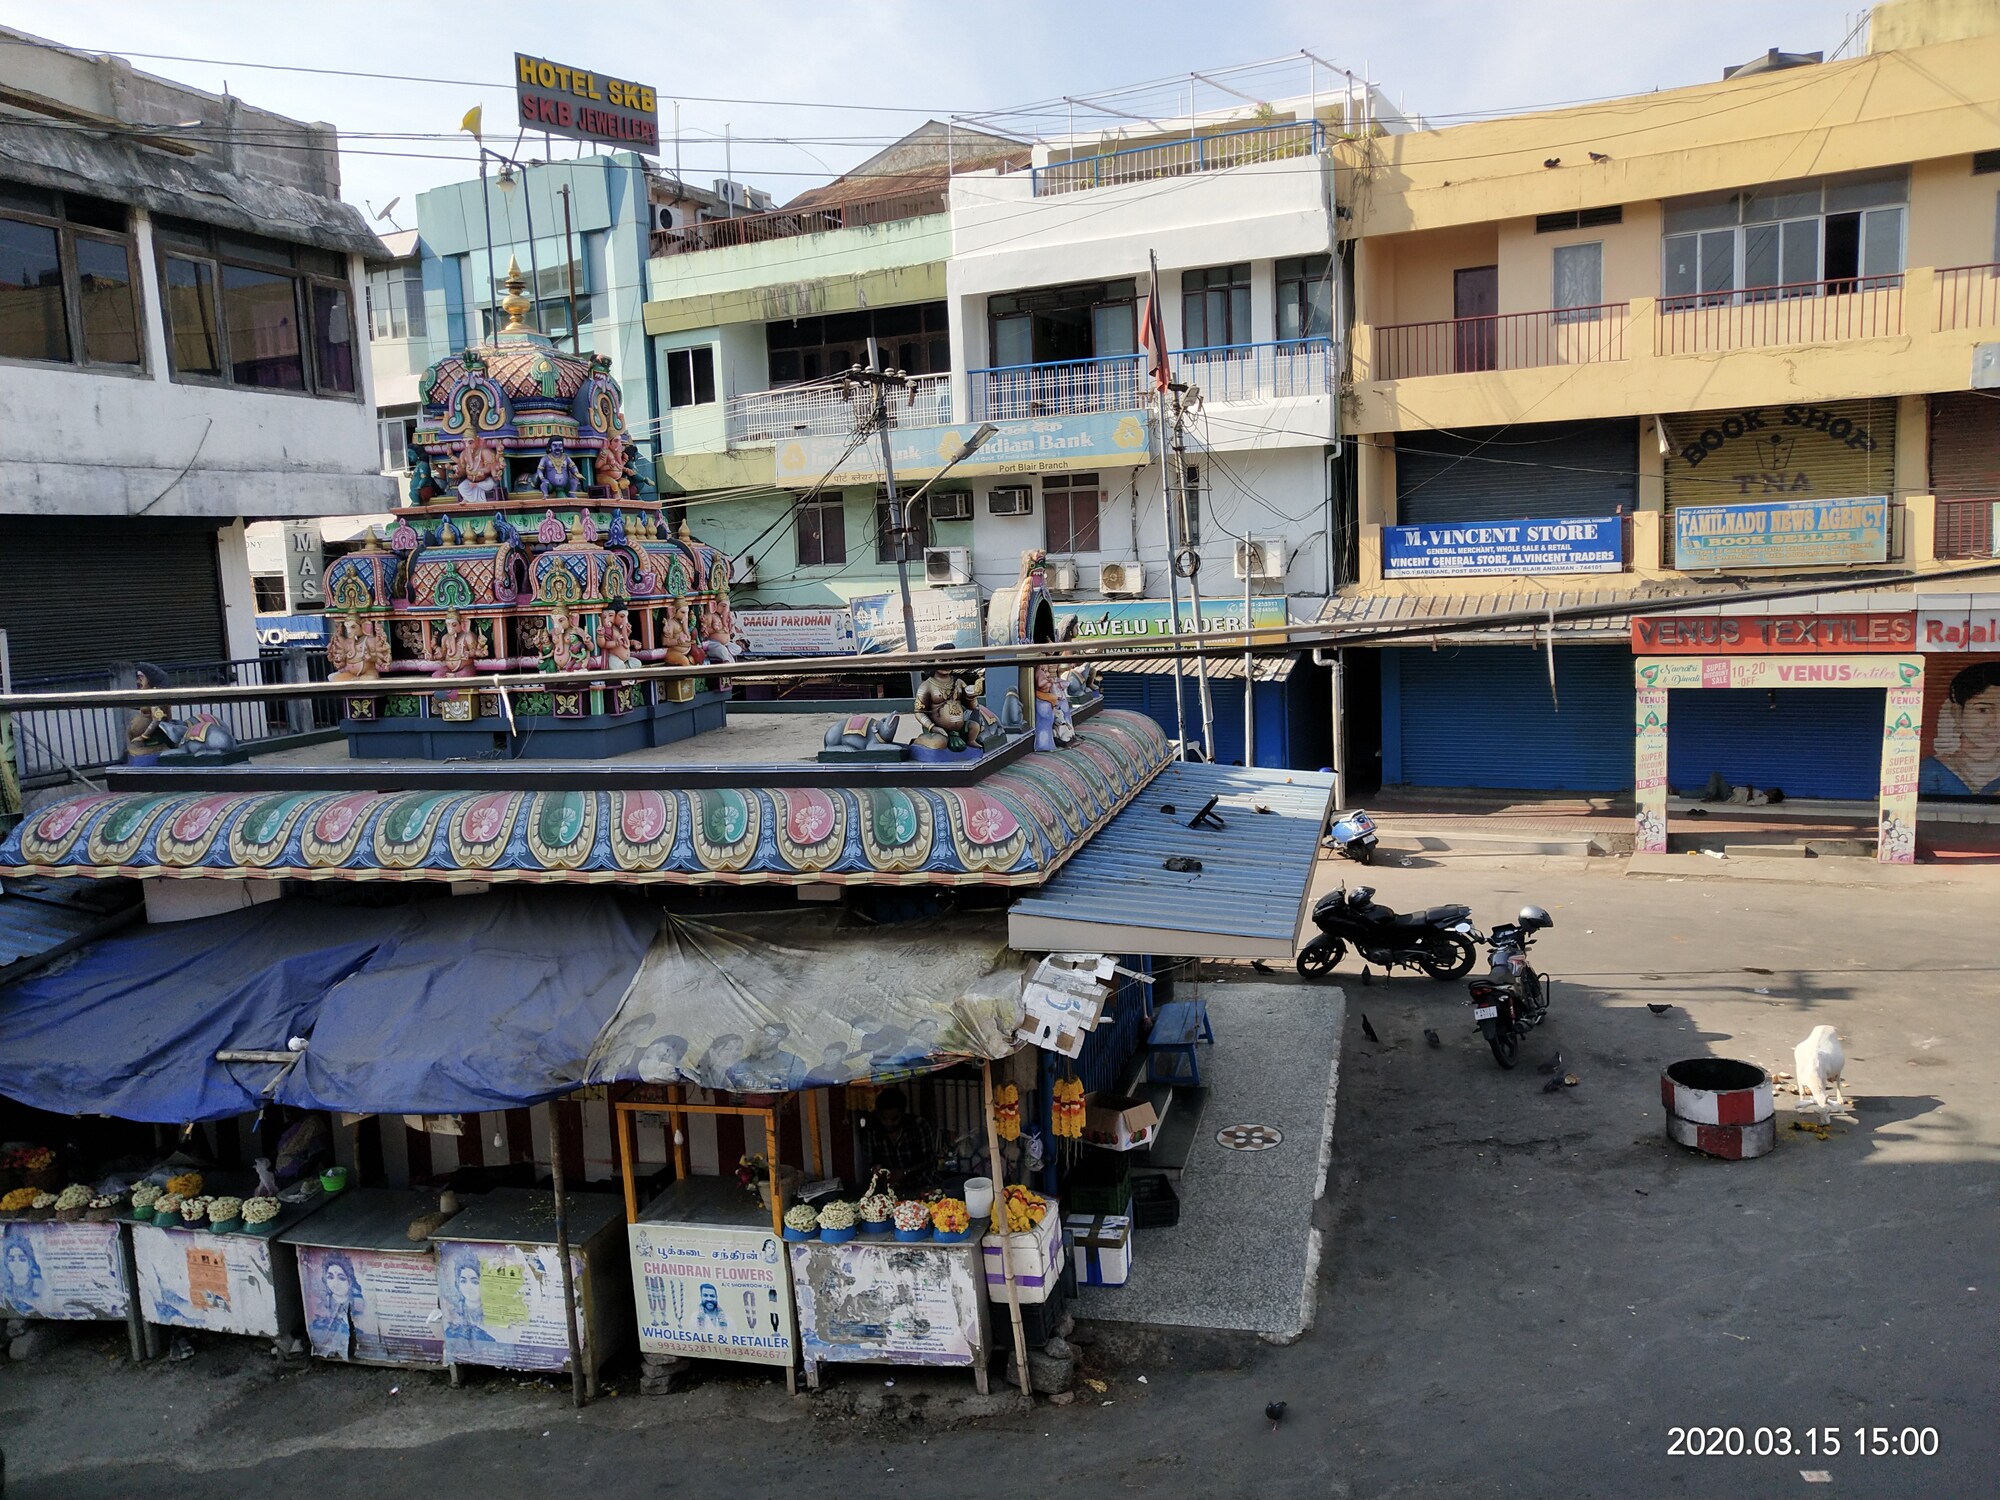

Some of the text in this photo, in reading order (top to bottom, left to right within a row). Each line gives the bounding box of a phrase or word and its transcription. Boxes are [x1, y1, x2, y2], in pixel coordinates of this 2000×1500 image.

[519, 56, 656, 113] HOTEL SKB
[522, 93, 573, 128] SKB
[1039, 431, 1095, 450] Bank
[1681, 404, 1878, 469] BOOK SHOP
[999, 461, 1069, 473] Port Blair Branch
[1732, 471, 1815, 495] TNA
[1679, 504, 1884, 537] TAMILNADU NEWS AGENCY
[1404, 523, 1598, 547] M.VINCENT STORE
[1708, 532, 1852, 547] BOOK SELLER
[1457, 546, 1495, 555] MERCHANT,
[1547, 543, 1573, 551] RETAIL
[1390, 551, 1615, 568] VINCENT GENERAL STORE, M.VINCENT TRADERS
[1637, 617, 1912, 645] VENUS TEXTILES
[1926, 618, 2000, 649] Rajal
[1703, 669, 1730, 679] DISCOUNT
[1706, 662, 1727, 673] SUPER
[1777, 664, 1896, 682] VENUS textiles
[1711, 675, 1728, 685] SALE
[1638, 696, 1666, 704] VENUS
[1891, 696, 1921, 705] VENUS
[1640, 751, 1663, 762] SUPER
[1889, 755, 1915, 767] SUPER
[1638, 761, 1665, 770] DISCOUNT
[1647, 767, 1664, 778] SALE
[1885, 765, 1917, 775] DISCOUNT
[1894, 773, 1915, 784] SALE
[657, 1244, 759, 1261] பூக்கடை சந்திரன்
[643, 1262, 774, 1282] CHANDRAN FLOWERS
[642, 1327, 789, 1348] WHOLESALE & RETAILER
[725, 1347, 788, 1360] 9434262677
